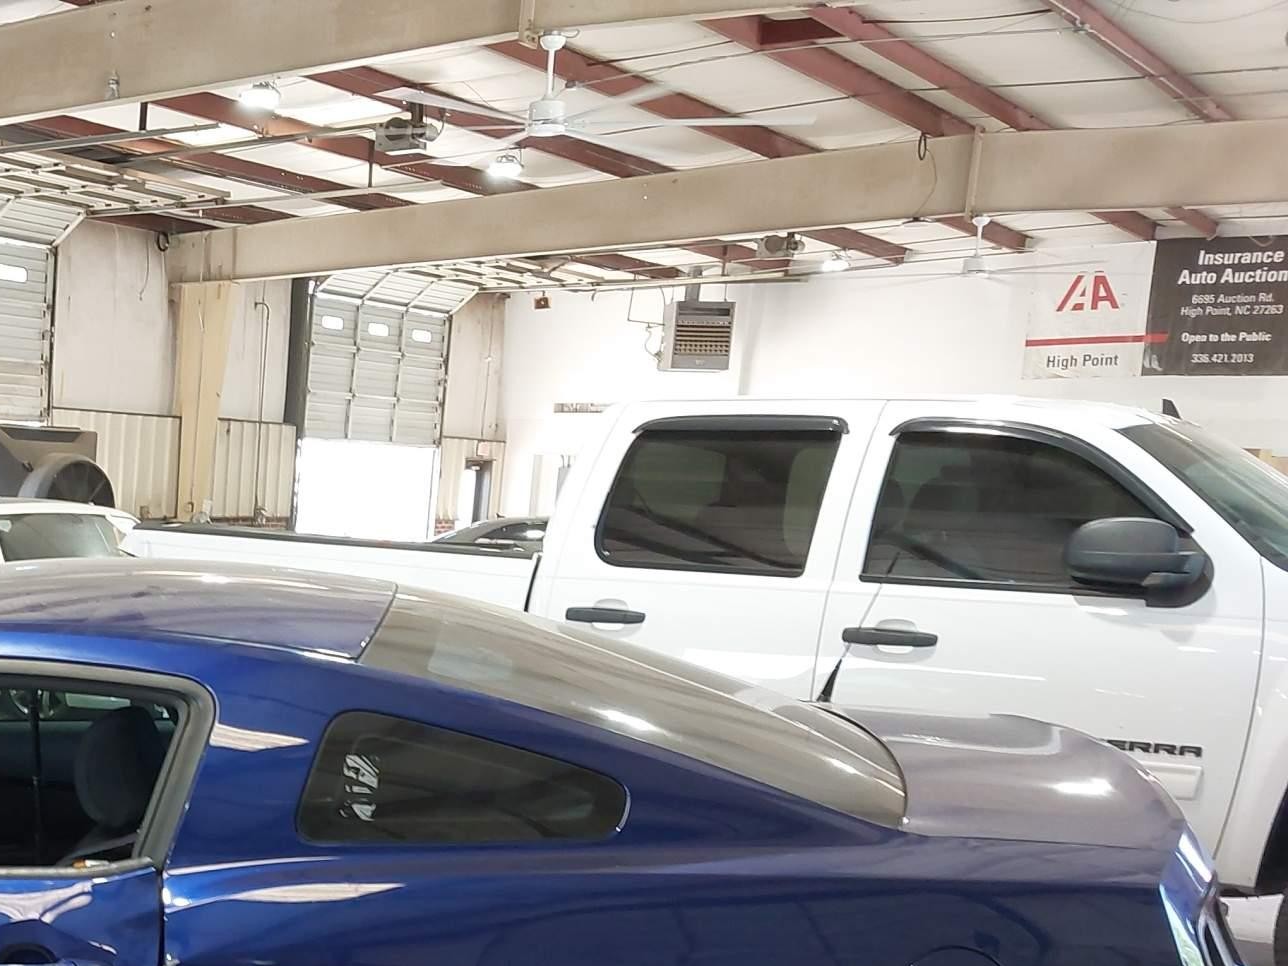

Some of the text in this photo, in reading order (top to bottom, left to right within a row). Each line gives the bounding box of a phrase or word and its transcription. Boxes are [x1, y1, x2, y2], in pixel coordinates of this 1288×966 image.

[1198, 250, 1285, 265] Insurance
[1177, 269, 1217, 285] Auto
[1217, 293, 1256, 304] Auction
[1180, 306, 1203, 318] High
[1234, 305, 1251, 315] NC
[1181, 331, 1272, 344] Open to the Public
[1046, 353, 1119, 370] High Point
[1106, 739, 1202, 758] ERRA
